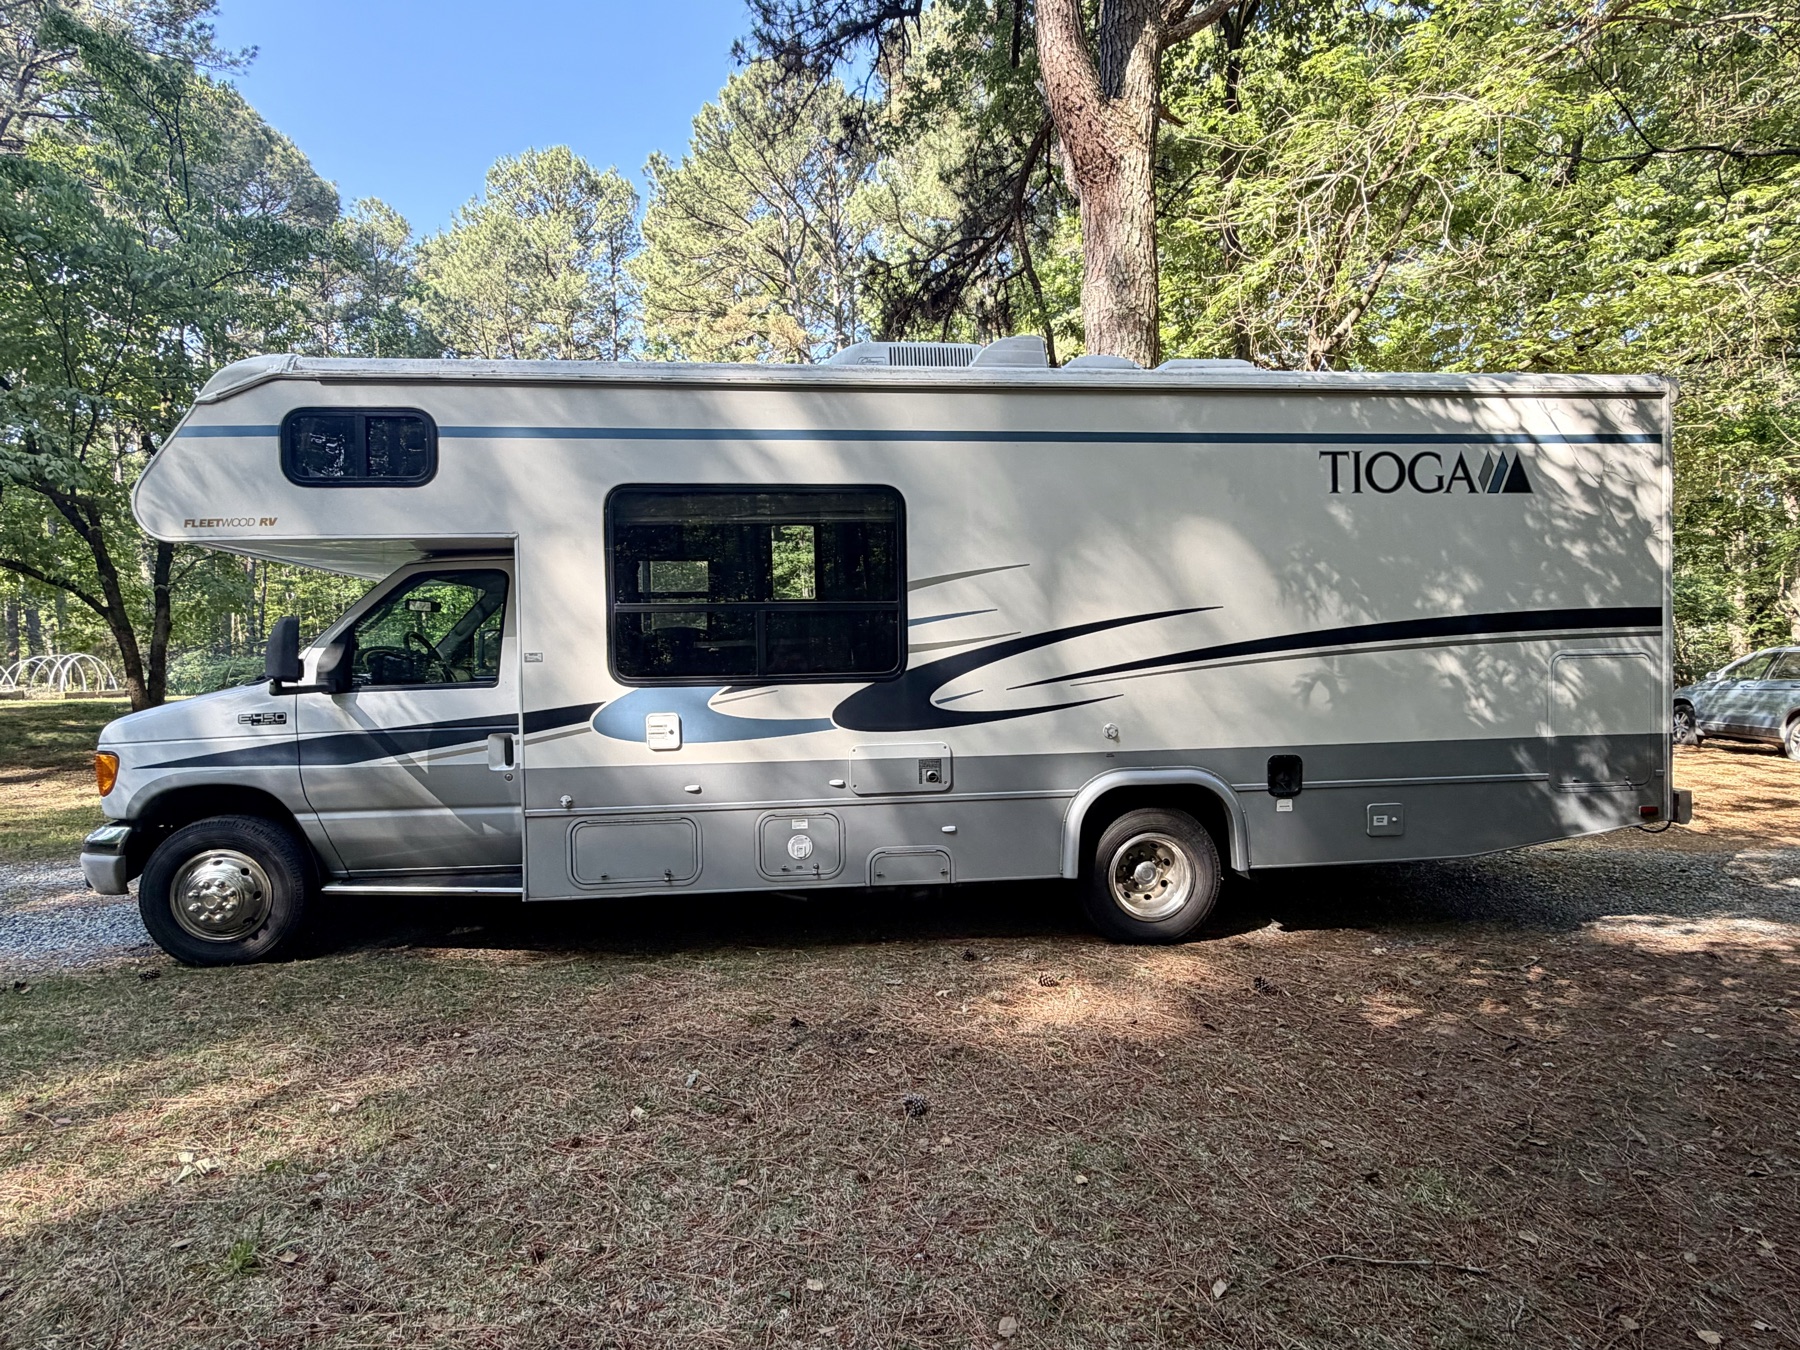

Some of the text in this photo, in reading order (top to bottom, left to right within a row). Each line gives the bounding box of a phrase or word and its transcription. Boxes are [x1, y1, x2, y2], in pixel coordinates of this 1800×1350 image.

[1318, 450, 1480, 494] TIOGA
[184, 517, 278, 528] FLEETWOOD RV
